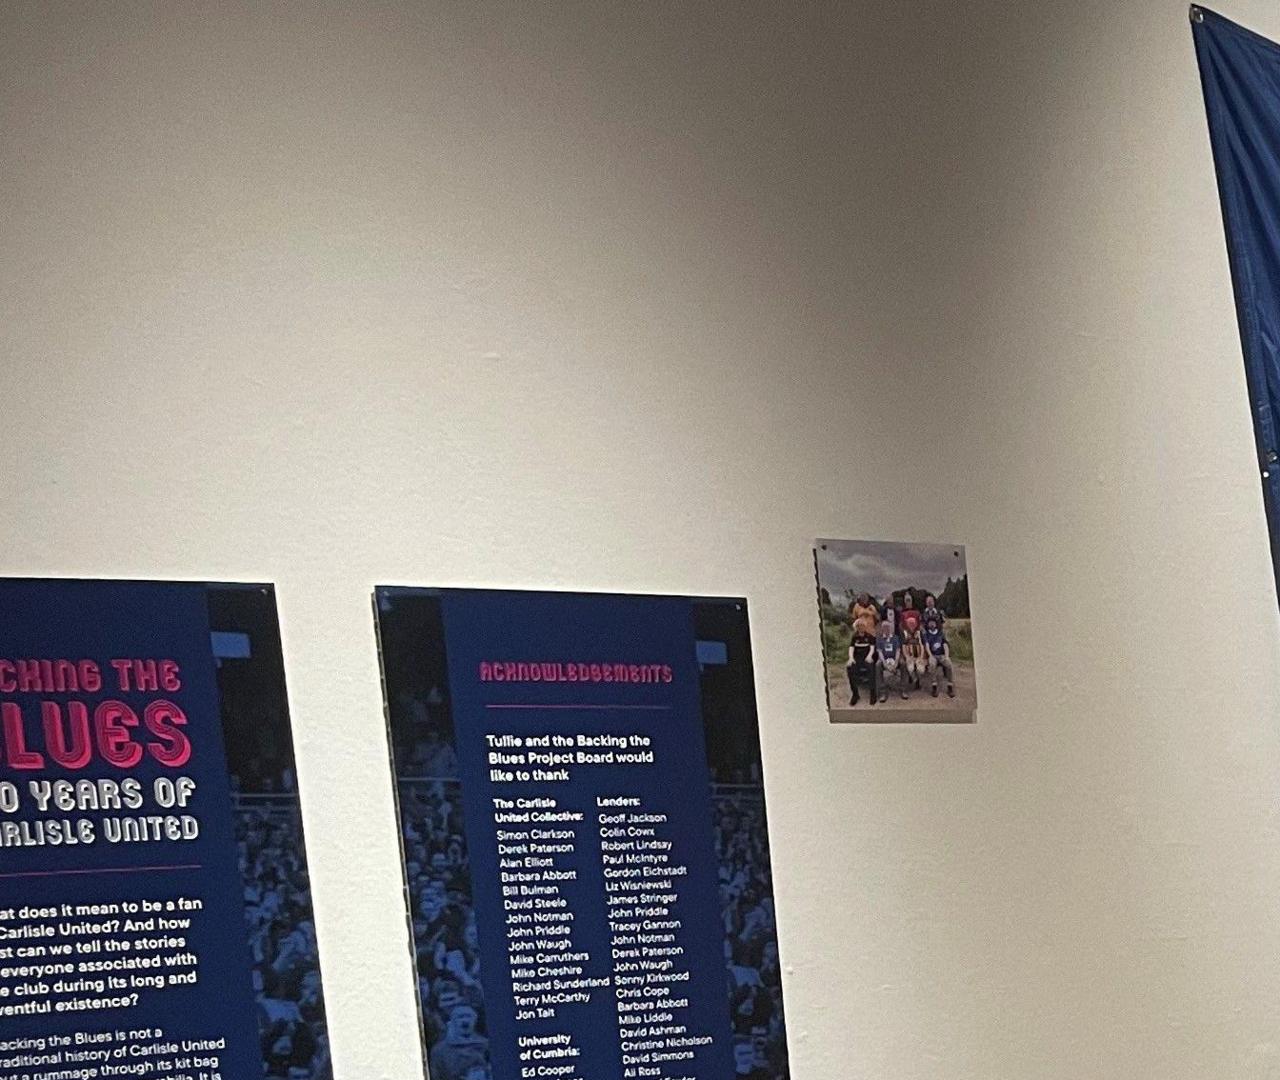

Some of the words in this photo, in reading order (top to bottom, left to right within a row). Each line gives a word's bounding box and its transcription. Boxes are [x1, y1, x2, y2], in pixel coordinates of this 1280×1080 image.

[486, 734, 522, 747] Tullie
[525, 735, 550, 747] and
[552, 735, 574, 747] the
[576, 734, 627, 748] Backing
[629, 734, 650, 746] the
[488, 752, 525, 764] Blues
[528, 752, 574, 766] Project
[576, 751, 614, 763] Board
[615, 751, 653, 763] would
[489, 769, 513, 781] like
[515, 770, 530, 781] to
[532, 769, 569, 781] thank
[29, 779, 143, 810] YEARS
[154, 777, 195, 807] OF
[492, 798, 514, 808] The
[516, 798, 556, 808] Carlisle
[598, 813, 625, 824] Geoff
[627, 813, 667, 823] Jackson
[103, 815, 198, 842] UNITED
[496, 830, 529, 840] Simon
[530, 829, 575, 839] Clarkson
[18, 906, 57, 919] does
[61, 903, 72, 916] it
[76, 904, 119, 915] mean
[122, 901, 138, 913] to
[142, 899, 162, 912] be
[166, 901, 175, 911] a
[177, 897, 202, 910] fan
[0, 924, 55, 939] Carlisle
[58, 920, 120, 935] United?
[123, 918, 154, 932] And
[158, 917, 190, 929] how
[16, 946, 46, 957] can
[48, 944, 72, 955] we
[75, 939, 101, 953] tell
[104, 939, 130, 951] the
[134, 935, 186, 950] stories
[508, 941, 535, 951] John
[535, 939, 572, 950] Waugh
[0, 963, 74, 977] everyone
[78, 955, 161, 972] associated
[164, 952, 197, 966] with
[14, 982, 49, 995] club
[53, 978, 104, 993] during
[108, 976, 127, 989] its
[130, 975, 165, 988] long
[168, 970, 197, 984] and
[55, 993, 138, 1011] existence?
[518, 1034, 571, 1047] University
[519, 1049, 531, 1060] of
[532, 1046, 580, 1059] Cumbria:
